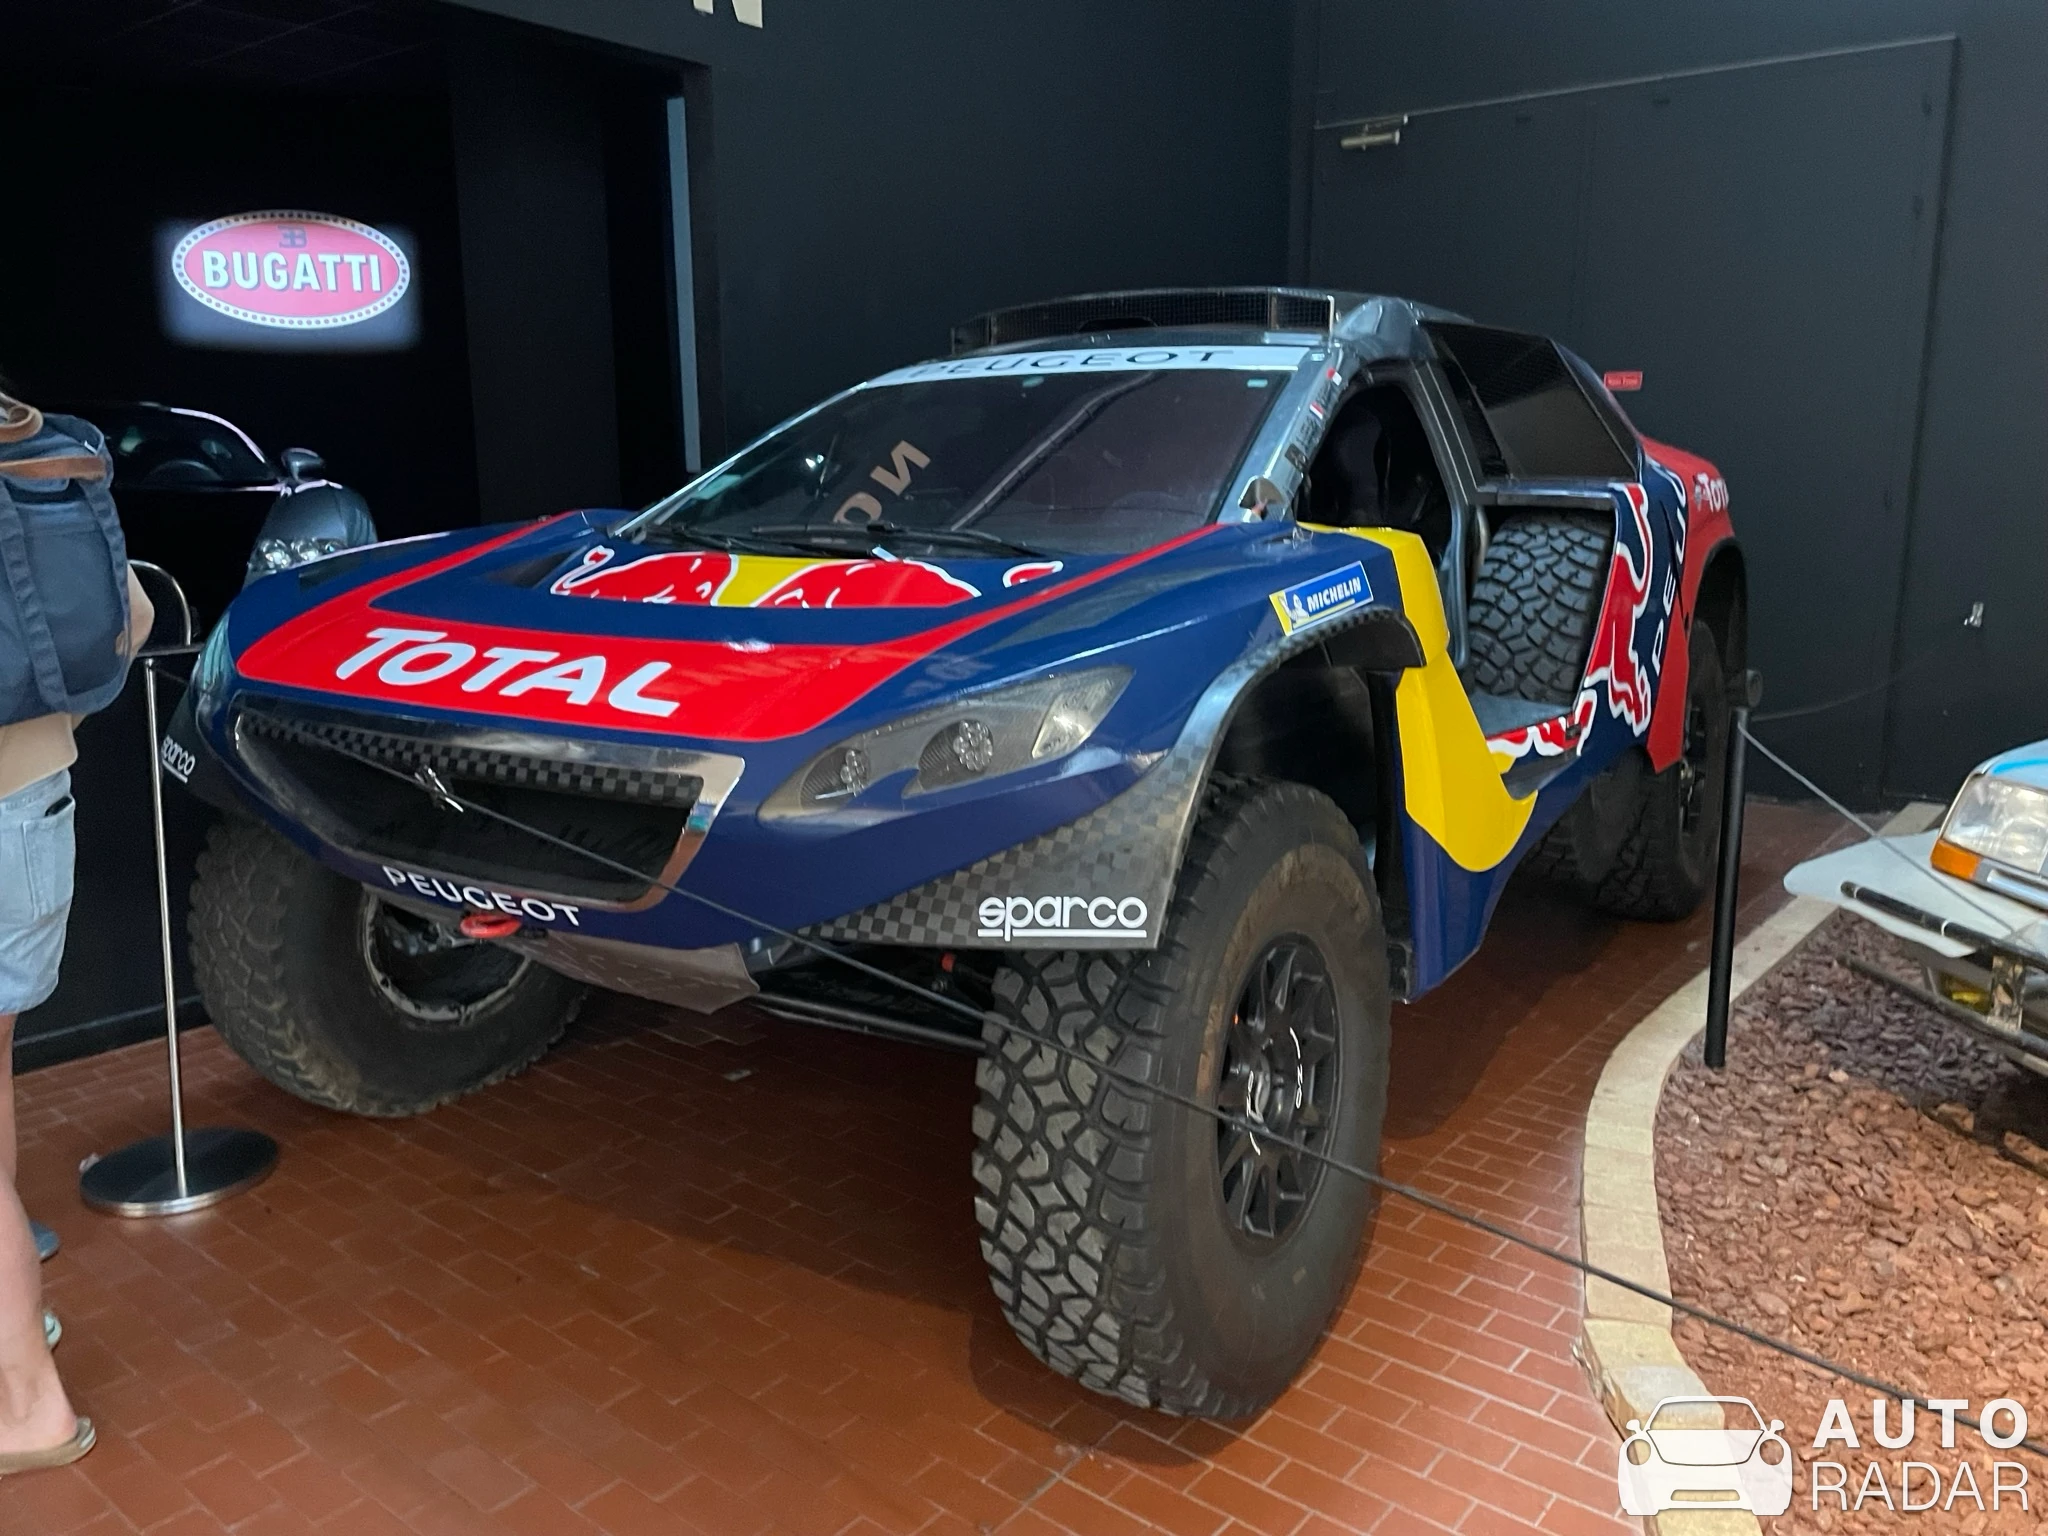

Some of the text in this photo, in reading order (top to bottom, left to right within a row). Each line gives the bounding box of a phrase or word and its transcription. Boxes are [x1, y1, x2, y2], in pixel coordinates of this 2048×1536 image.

[202, 250, 382, 292] BUGATTI
[909, 349, 1234, 379] PEUGEOT
[1306, 576, 1361, 613] MICHELIN
[336, 627, 681, 718] TOTAL
[382, 865, 580, 927] PEUGEOT
[978, 896, 1148, 942] sparco
